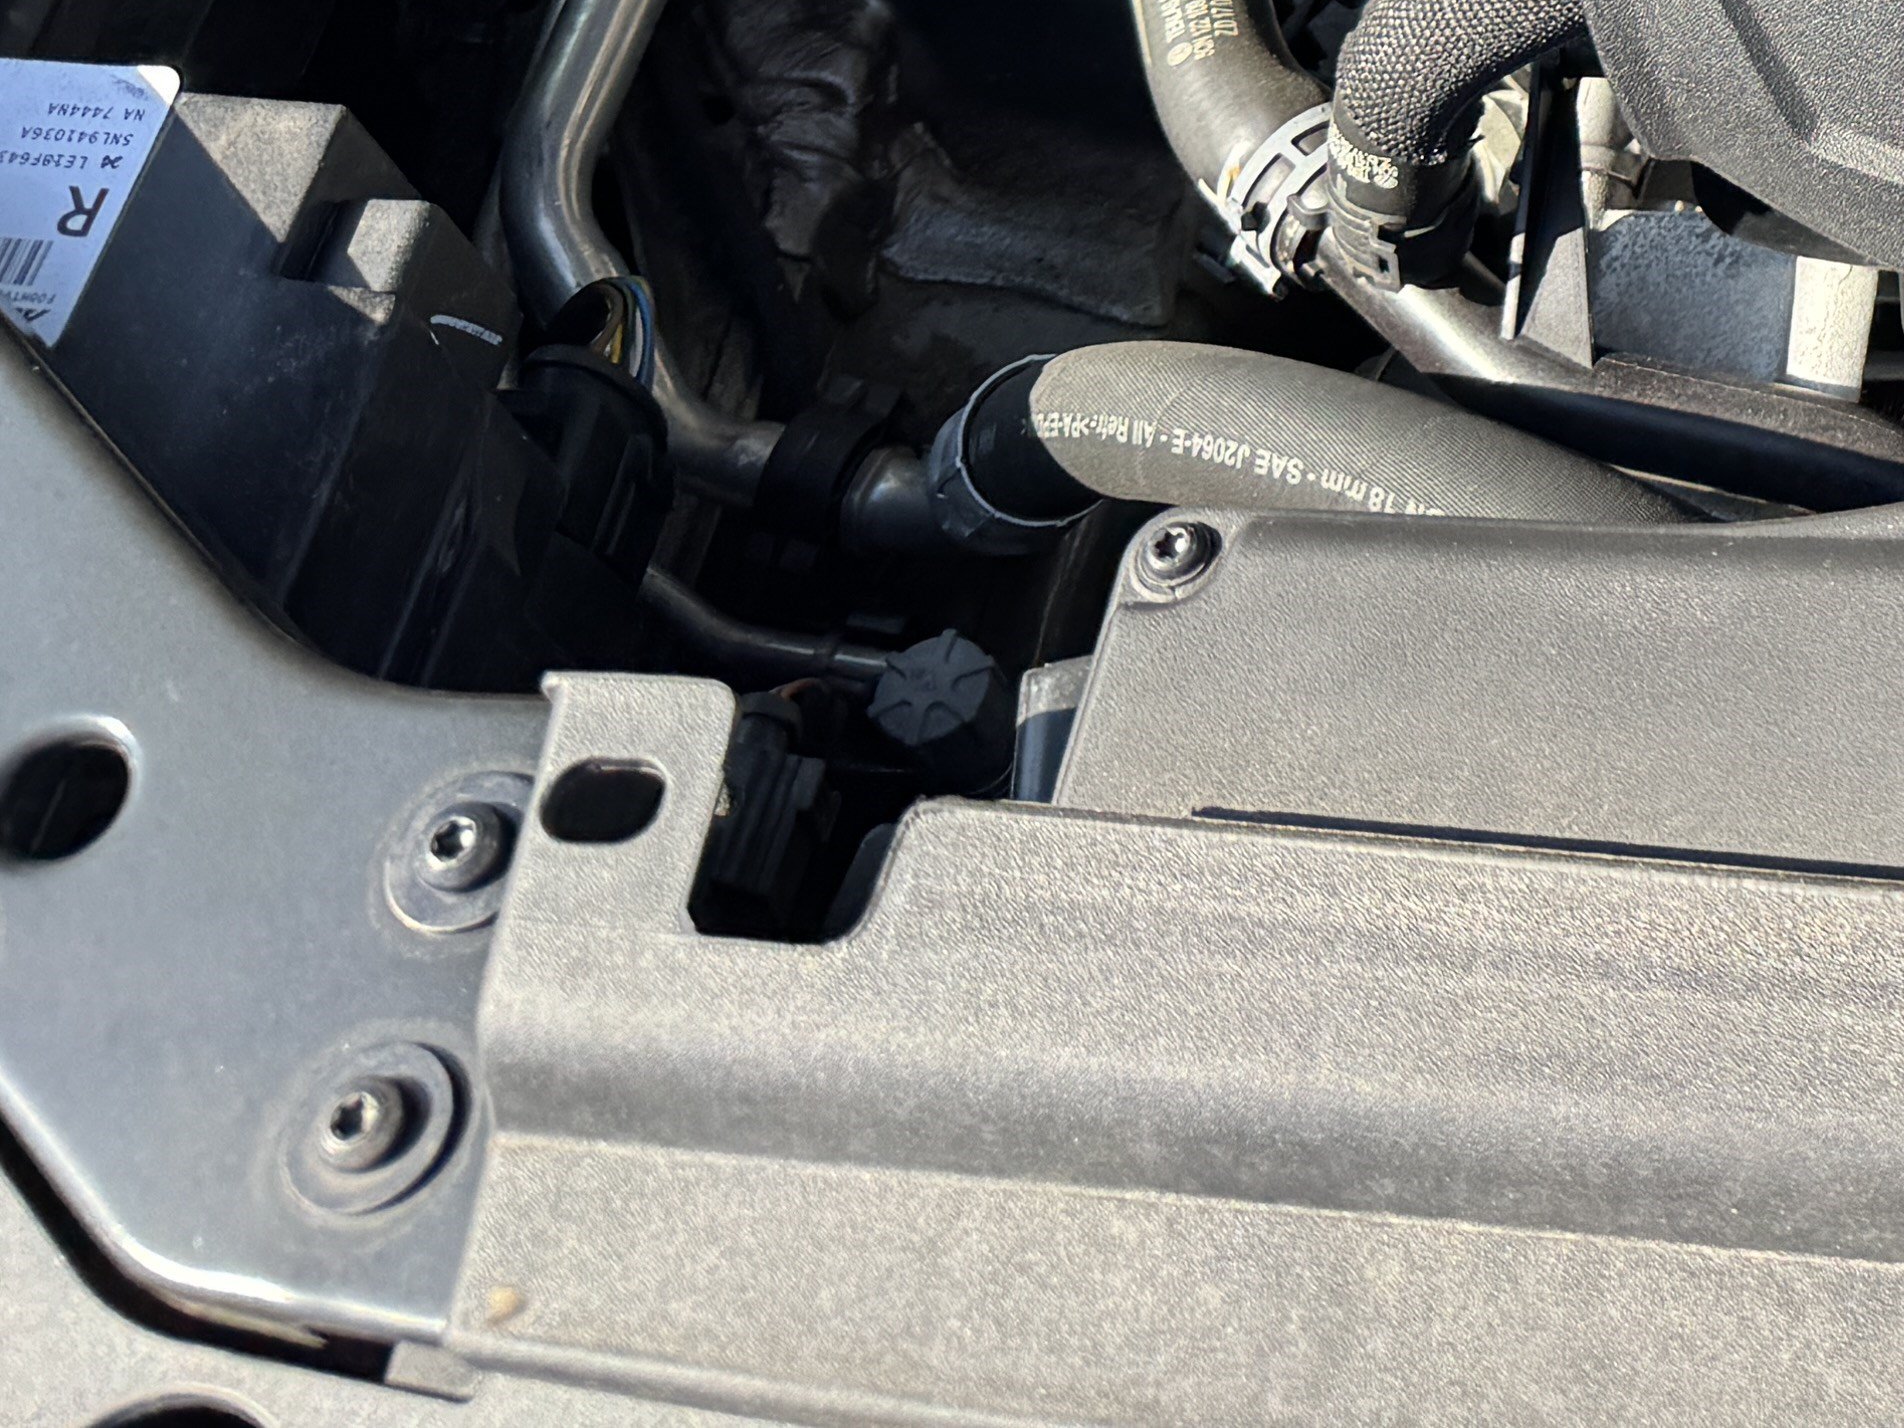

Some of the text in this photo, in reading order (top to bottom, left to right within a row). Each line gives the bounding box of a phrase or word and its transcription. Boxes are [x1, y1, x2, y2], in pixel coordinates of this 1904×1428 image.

[48, 101, 146, 121] NA 7444NA
[56, 185, 110, 238] R
[1132, 419, 1158, 447] All
[1171, 428, 1249, 469] J2064-E
[1253, 448, 1304, 485] SAE
[1320, 468, 1369, 502] mm
